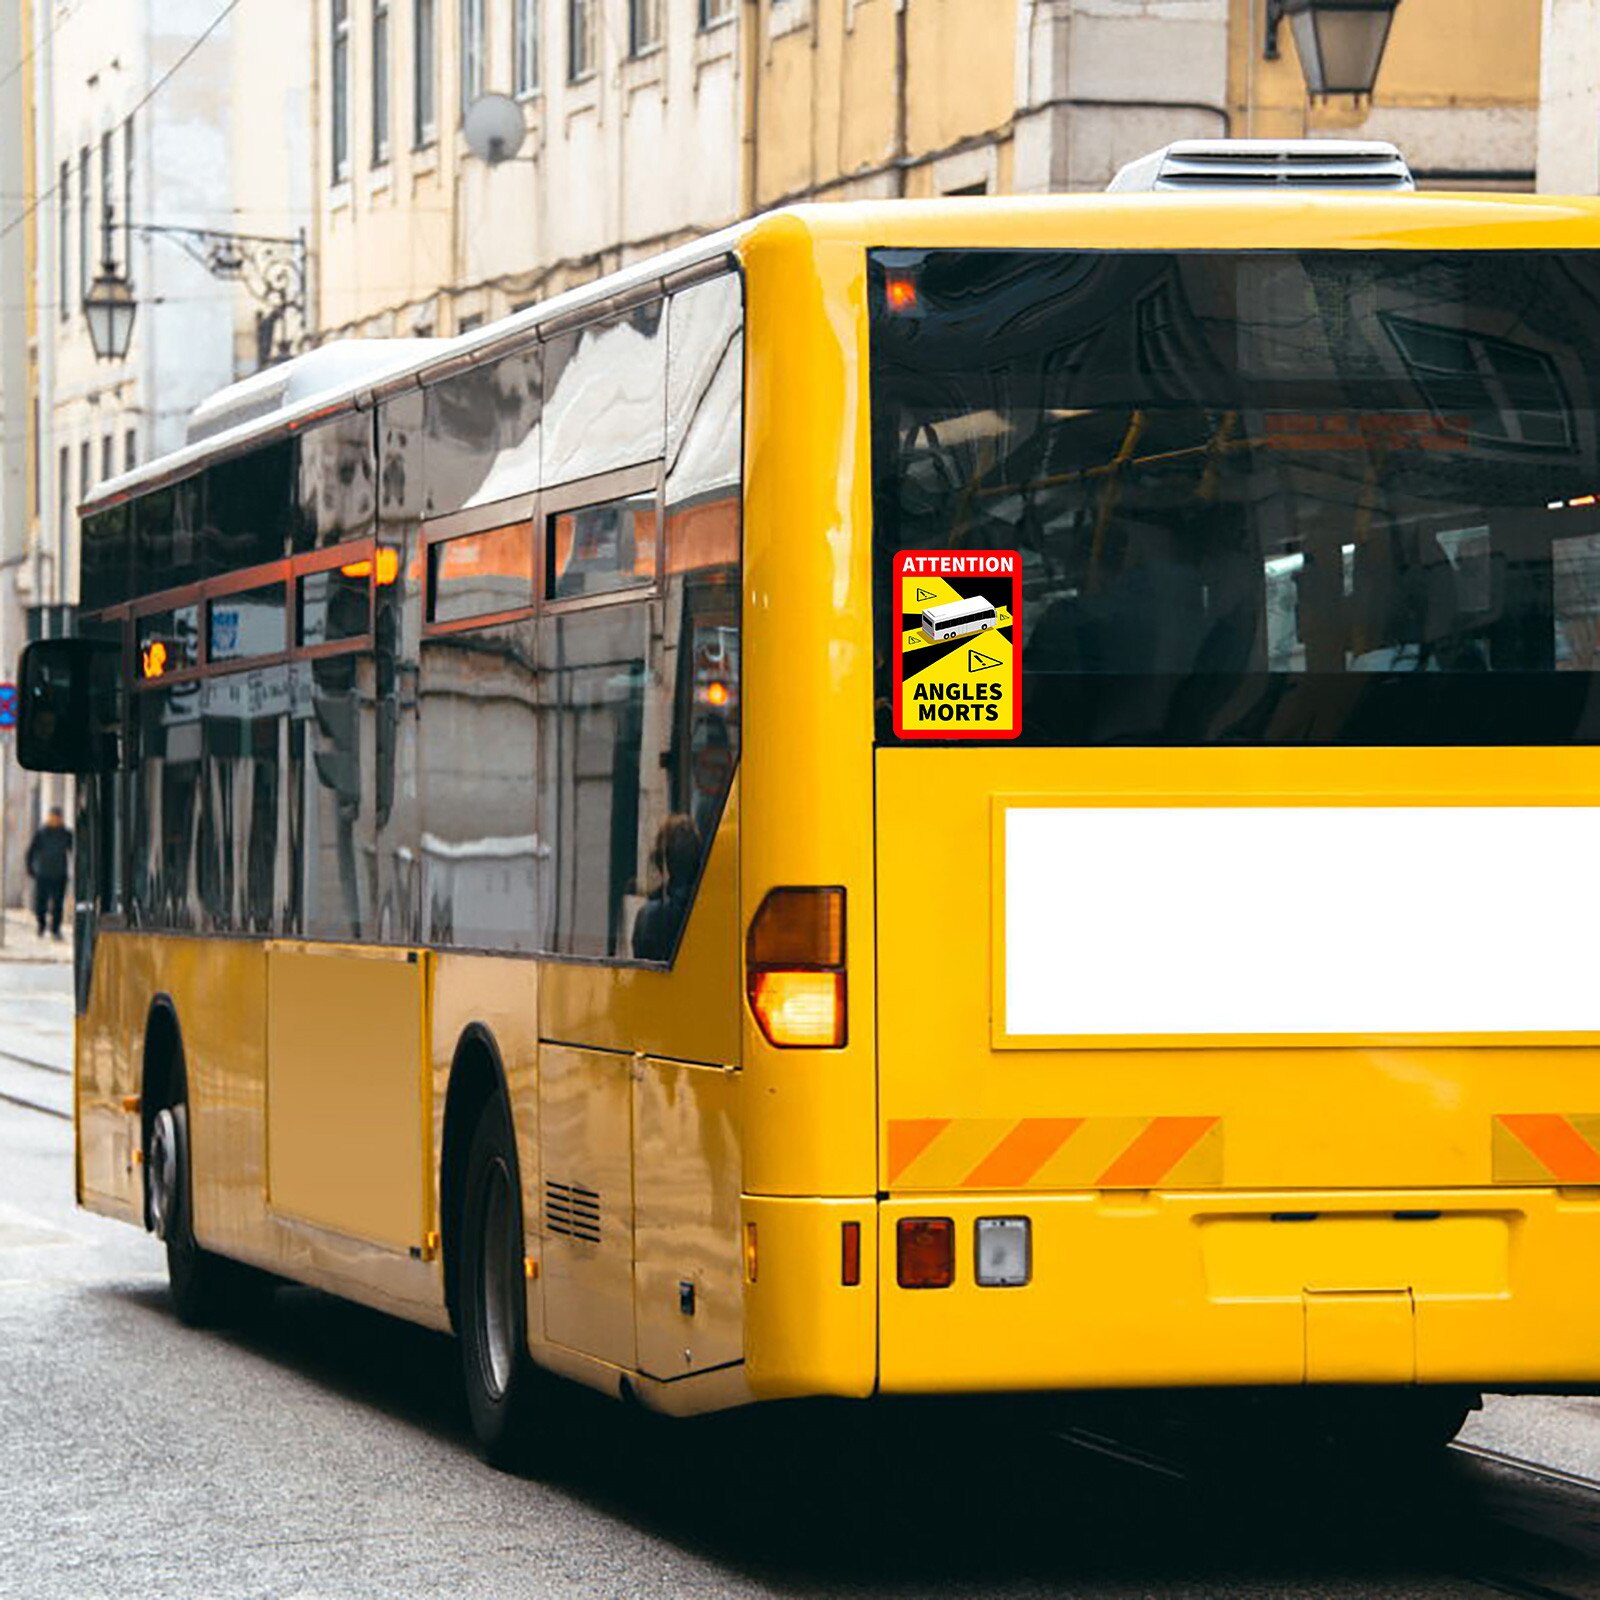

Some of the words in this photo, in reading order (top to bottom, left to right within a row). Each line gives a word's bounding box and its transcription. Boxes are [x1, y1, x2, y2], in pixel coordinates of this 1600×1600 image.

[902, 557, 1013, 572] ATTENTION
[913, 683, 1003, 701] ANGLES
[918, 703, 999, 722] MORTS
